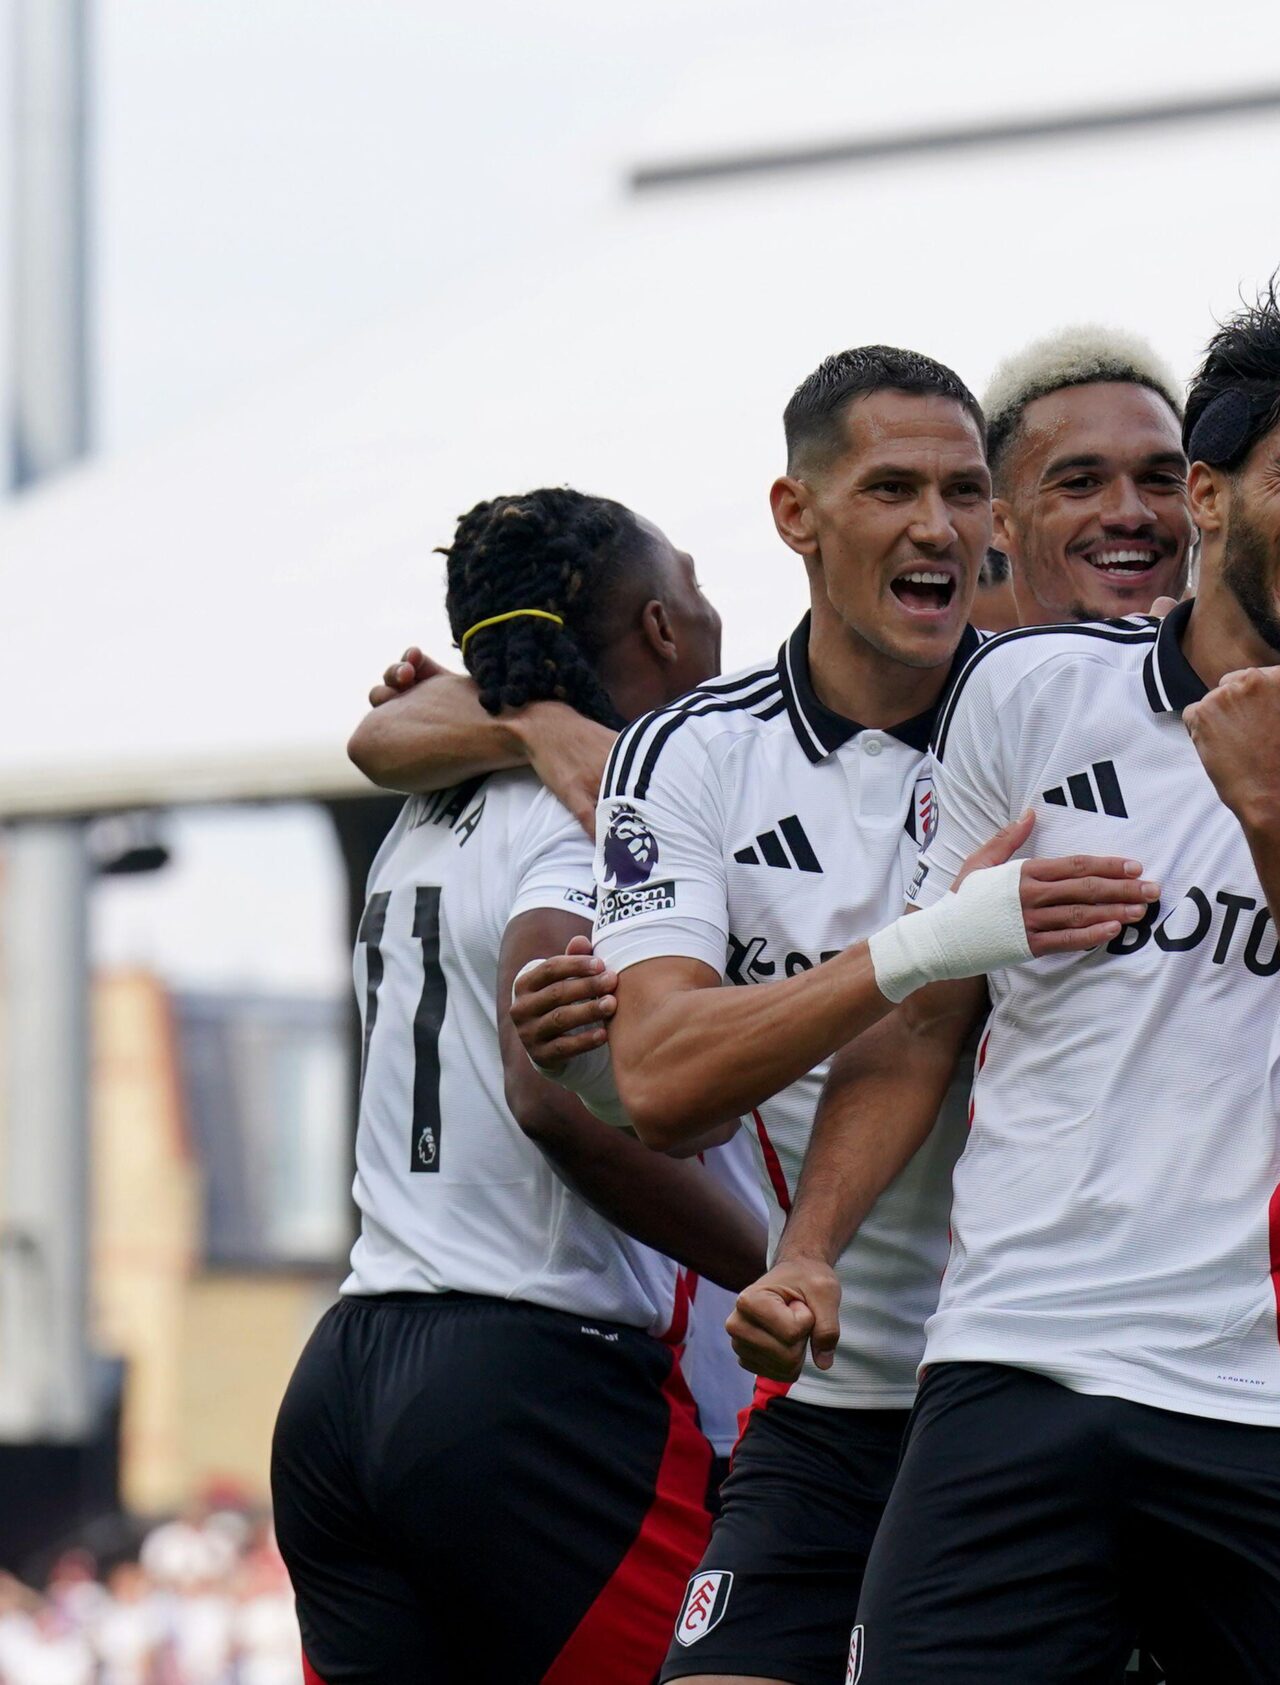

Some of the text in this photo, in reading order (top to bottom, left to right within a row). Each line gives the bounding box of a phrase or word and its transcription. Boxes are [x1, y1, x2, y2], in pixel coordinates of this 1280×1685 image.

[615, 886, 666, 907] room
[615, 896, 675, 922] racism
[359, 886, 448, 1174] 11
